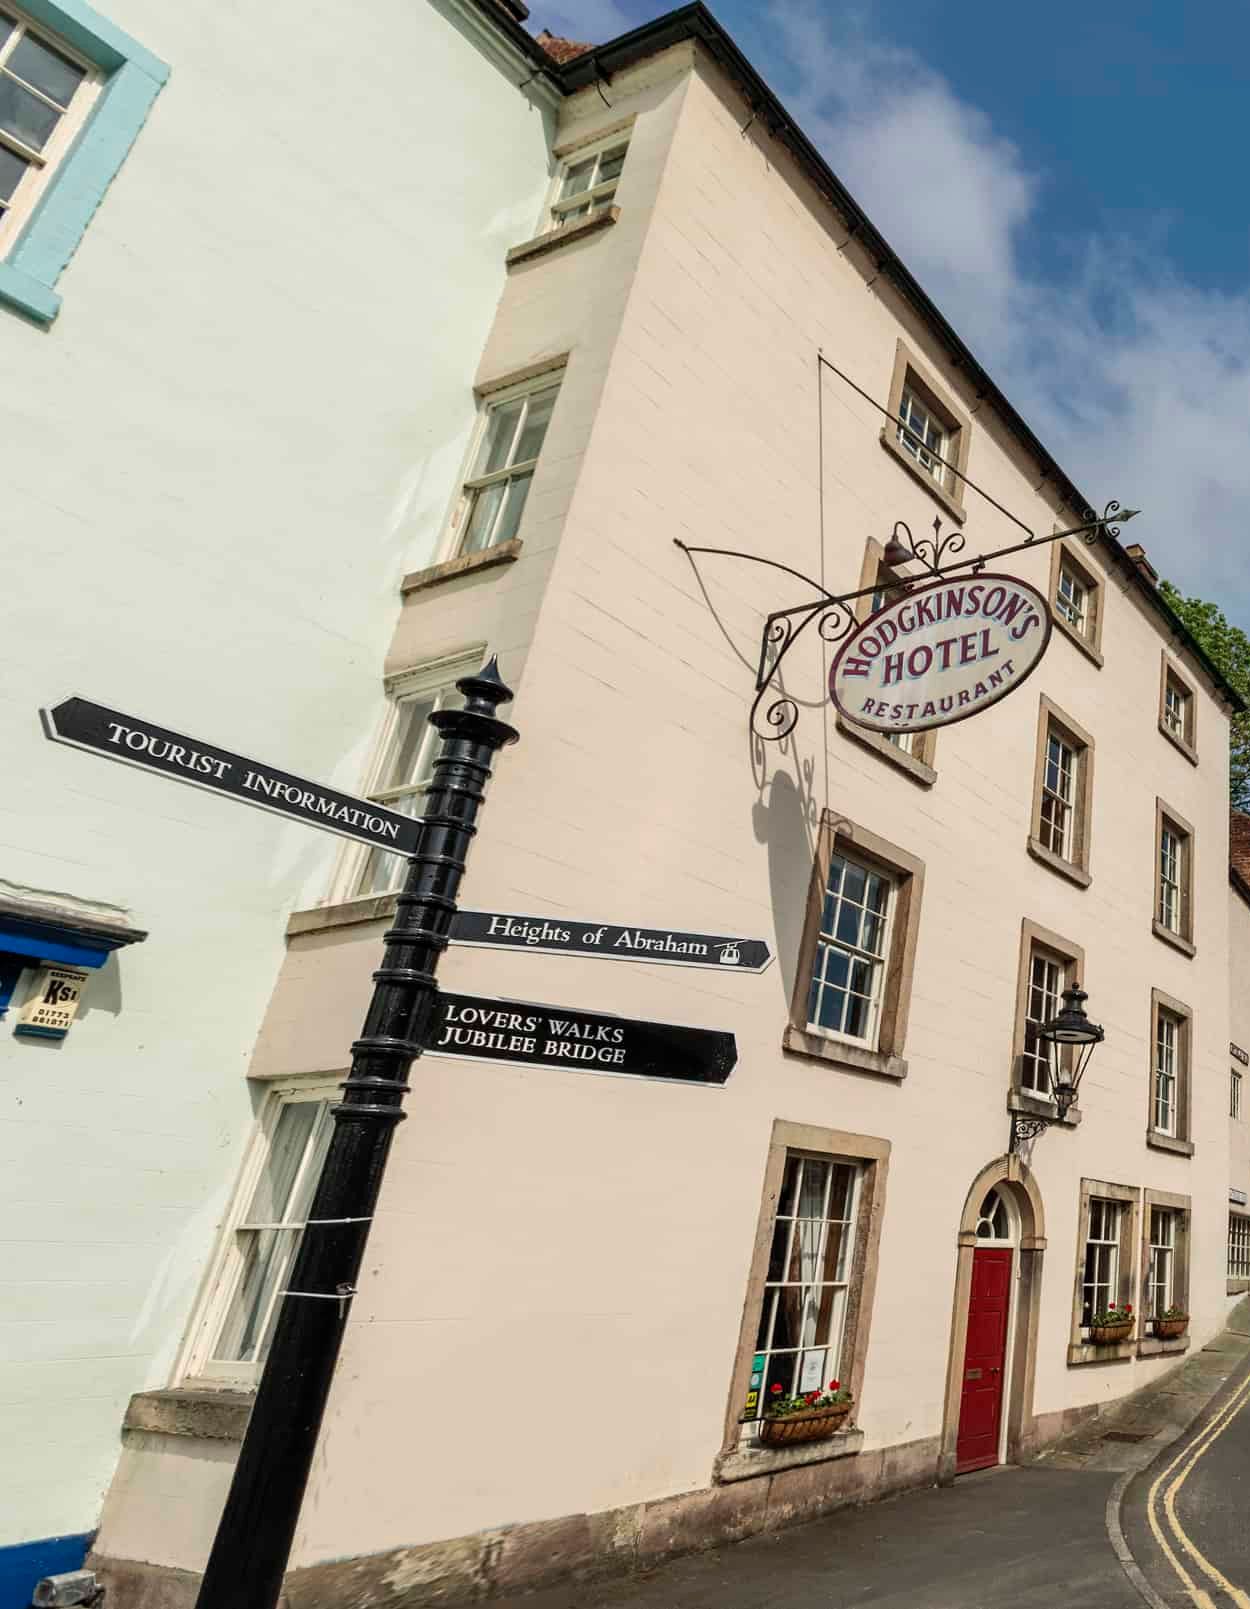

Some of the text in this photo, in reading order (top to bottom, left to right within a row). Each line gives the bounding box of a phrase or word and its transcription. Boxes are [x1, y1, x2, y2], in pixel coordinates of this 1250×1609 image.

[841, 585, 1040, 678] HODGKINSON'S
[882, 628, 1000, 686] HOTEL
[860, 659, 1017, 720] RESTAURANT
[108, 723, 400, 840] TOURIST INFORMATION
[486, 916, 708, 955] Heights of Abraham
[438, 1026, 626, 1064] JUBILEE BRIDGE
[445, 1005, 625, 1043] LOVERS' WALKS
